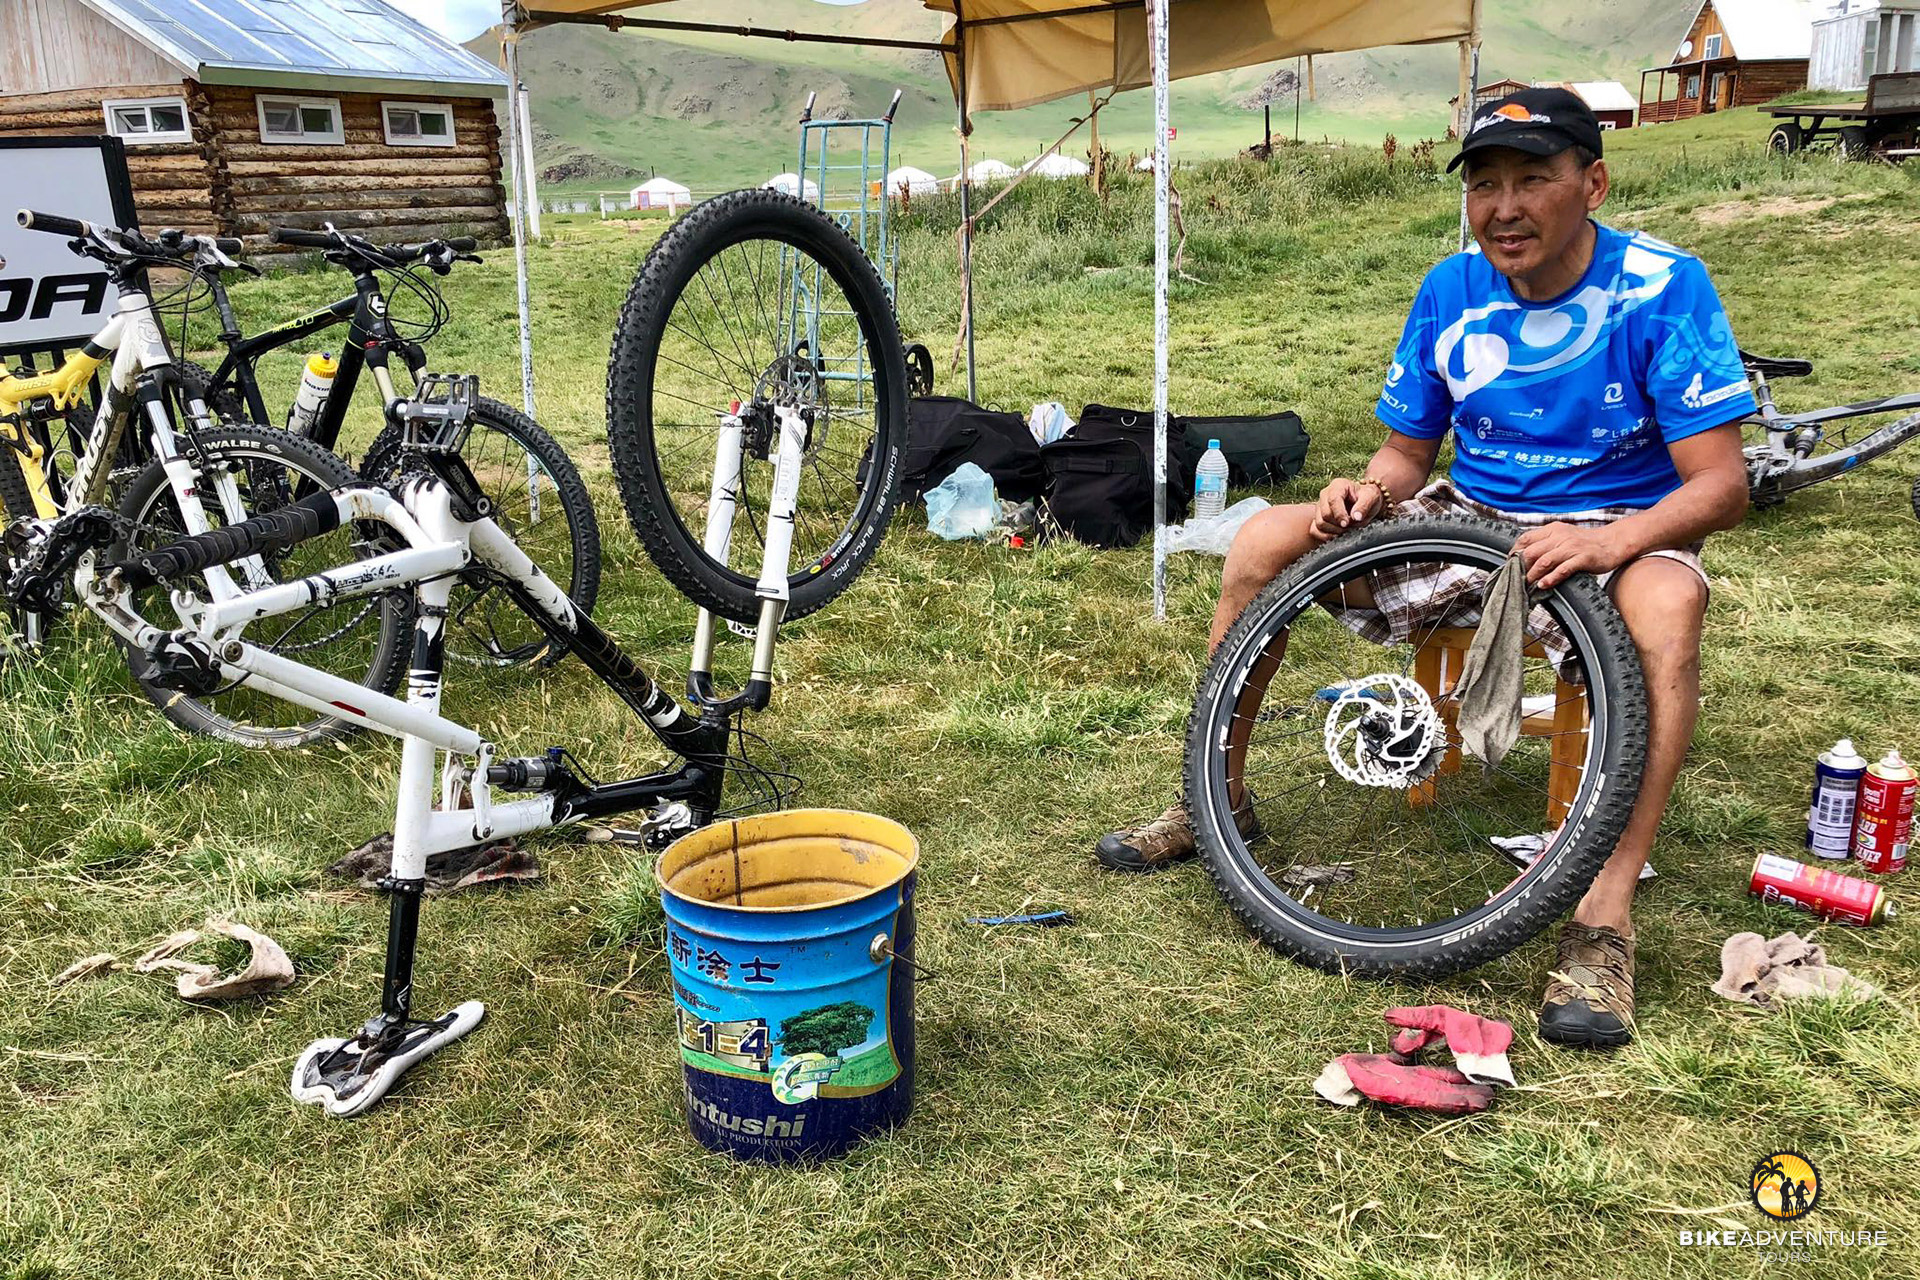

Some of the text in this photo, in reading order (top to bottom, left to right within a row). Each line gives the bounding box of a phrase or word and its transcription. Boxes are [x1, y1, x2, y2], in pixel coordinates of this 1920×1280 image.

[877, 445, 898, 515] SCHWALBE
[830, 558, 851, 581] JACK
[851, 525, 875, 559] BLACK
[1207, 571, 1305, 700] SCHWALBE
[1441, 823, 1586, 946] SMART SAM
